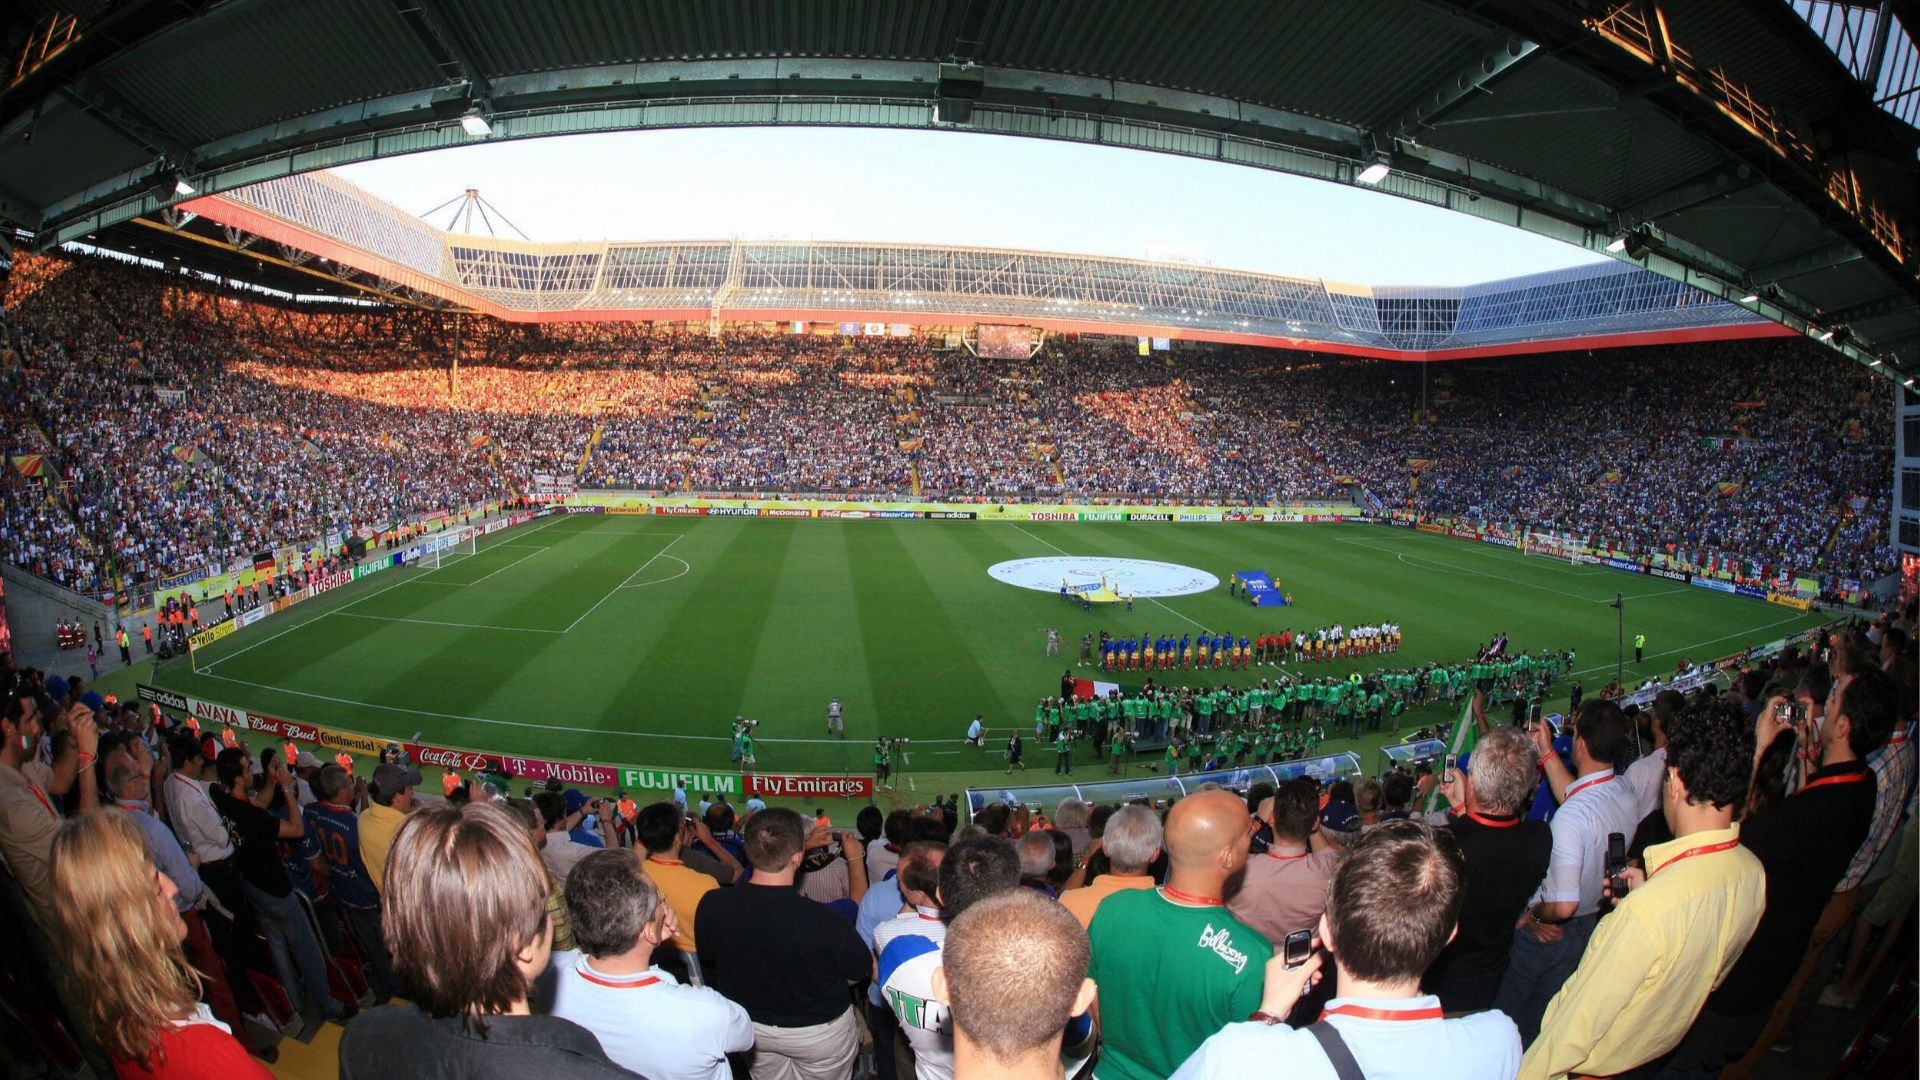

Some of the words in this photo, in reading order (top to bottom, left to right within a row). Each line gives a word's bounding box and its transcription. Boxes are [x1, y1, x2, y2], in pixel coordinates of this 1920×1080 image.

[566, 506, 595, 514] YAHOO!
[720, 508, 758, 516] HYUNDAI
[769, 509, 809, 517] McDonald's
[880, 511, 914, 519] MasterCard
[1031, 512, 1075, 521] TOSHIBA
[1084, 513, 1121, 521] FUJIFILM
[1489, 536, 1516, 547] HYUNDAI
[358, 557, 389, 576] FUJIFILM
[1609, 560, 1637, 571] MasterCard
[313, 570, 352, 594] TOSHIBA
[1664, 571, 1686, 581] adidas
[197, 631, 215, 647] Yello
[156, 692, 186, 710] adidas
[195, 701, 241, 726] AVAYA
[248, 715, 278, 732] Bud
[282, 723, 316, 741] Bud
[320, 732, 374, 751] Continental
[419, 747, 462, 767] Coca-Cola
[625, 770, 735, 792] FUJIFILM
[752, 776, 782, 795] Fly
[785, 777, 864, 792] Emirates
[1197, 923, 1248, 975] Billabong
